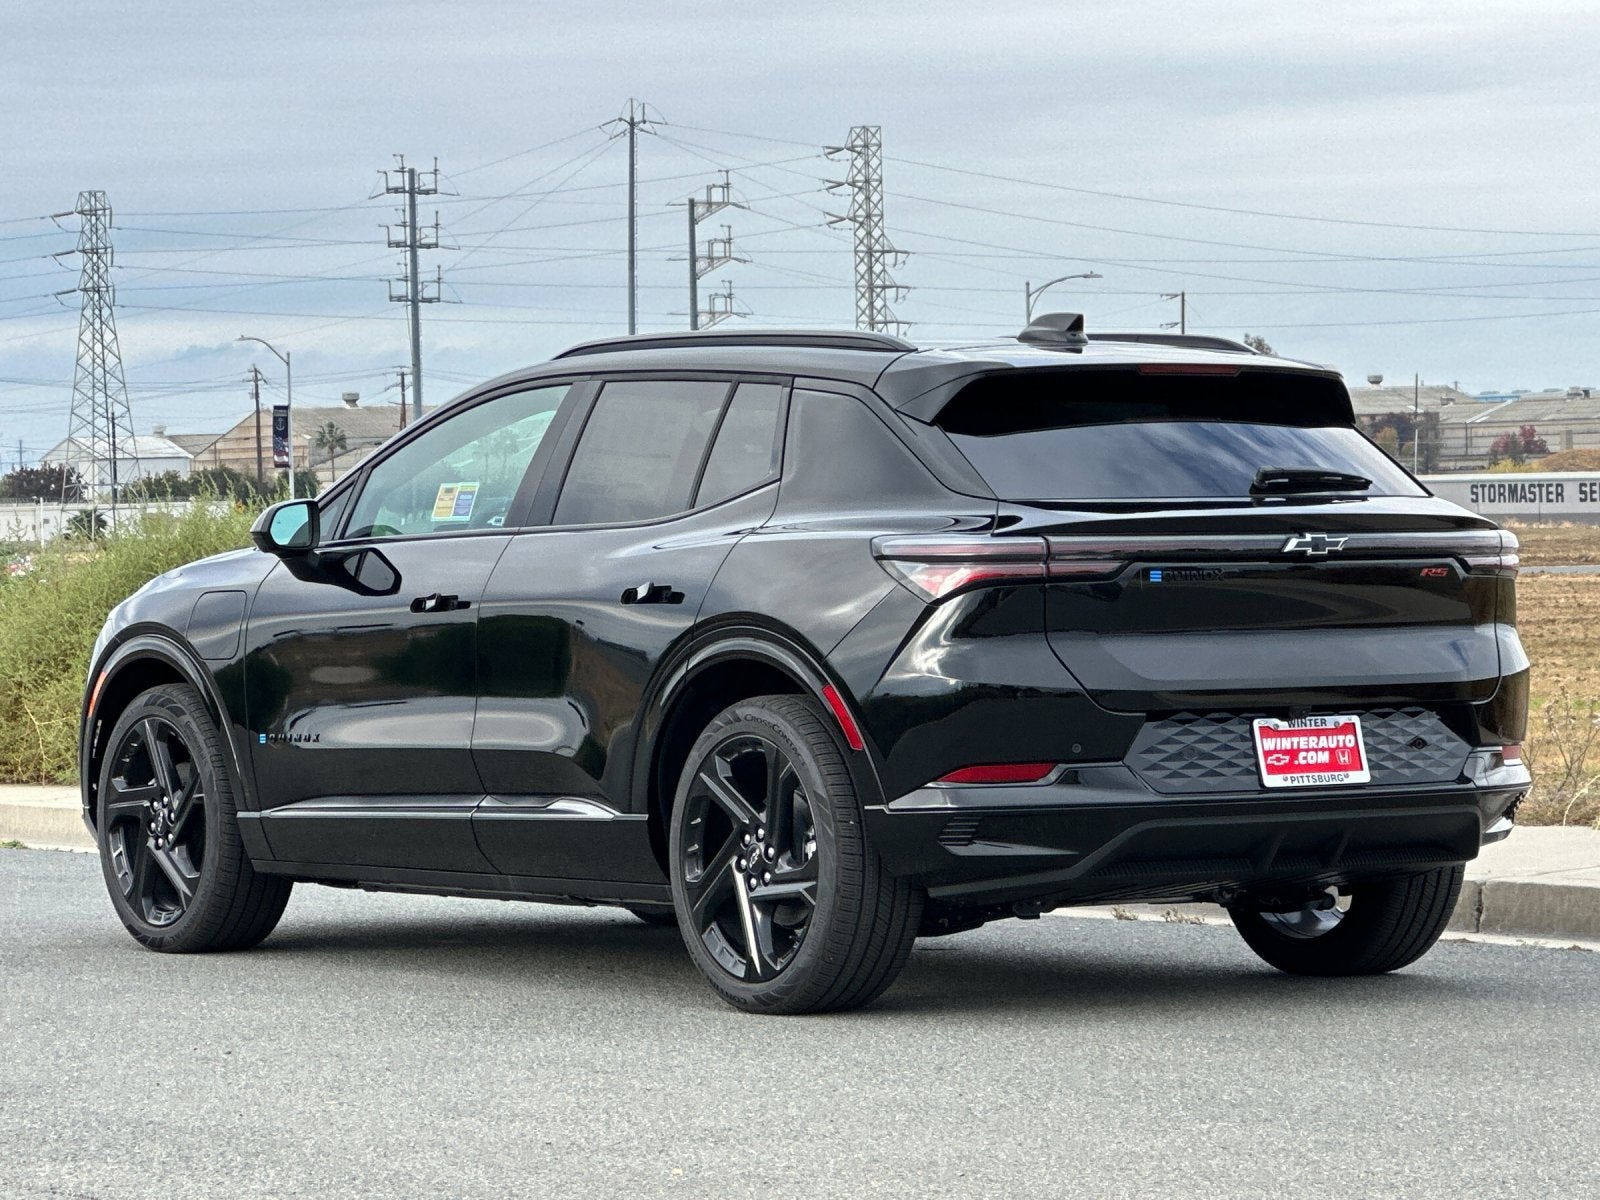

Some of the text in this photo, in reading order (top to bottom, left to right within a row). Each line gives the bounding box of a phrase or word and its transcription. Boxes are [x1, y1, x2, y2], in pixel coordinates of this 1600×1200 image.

[1470, 482, 1600, 503] STORMASTER SE
[1420, 567, 1449, 577] RS
[1288, 718, 1327, 728] WINTER
[1263, 735, 1355, 750] WINTERAUTO
[1294, 750, 1330, 765] .COM
[1290, 774, 1345, 784] PITTSBURG
